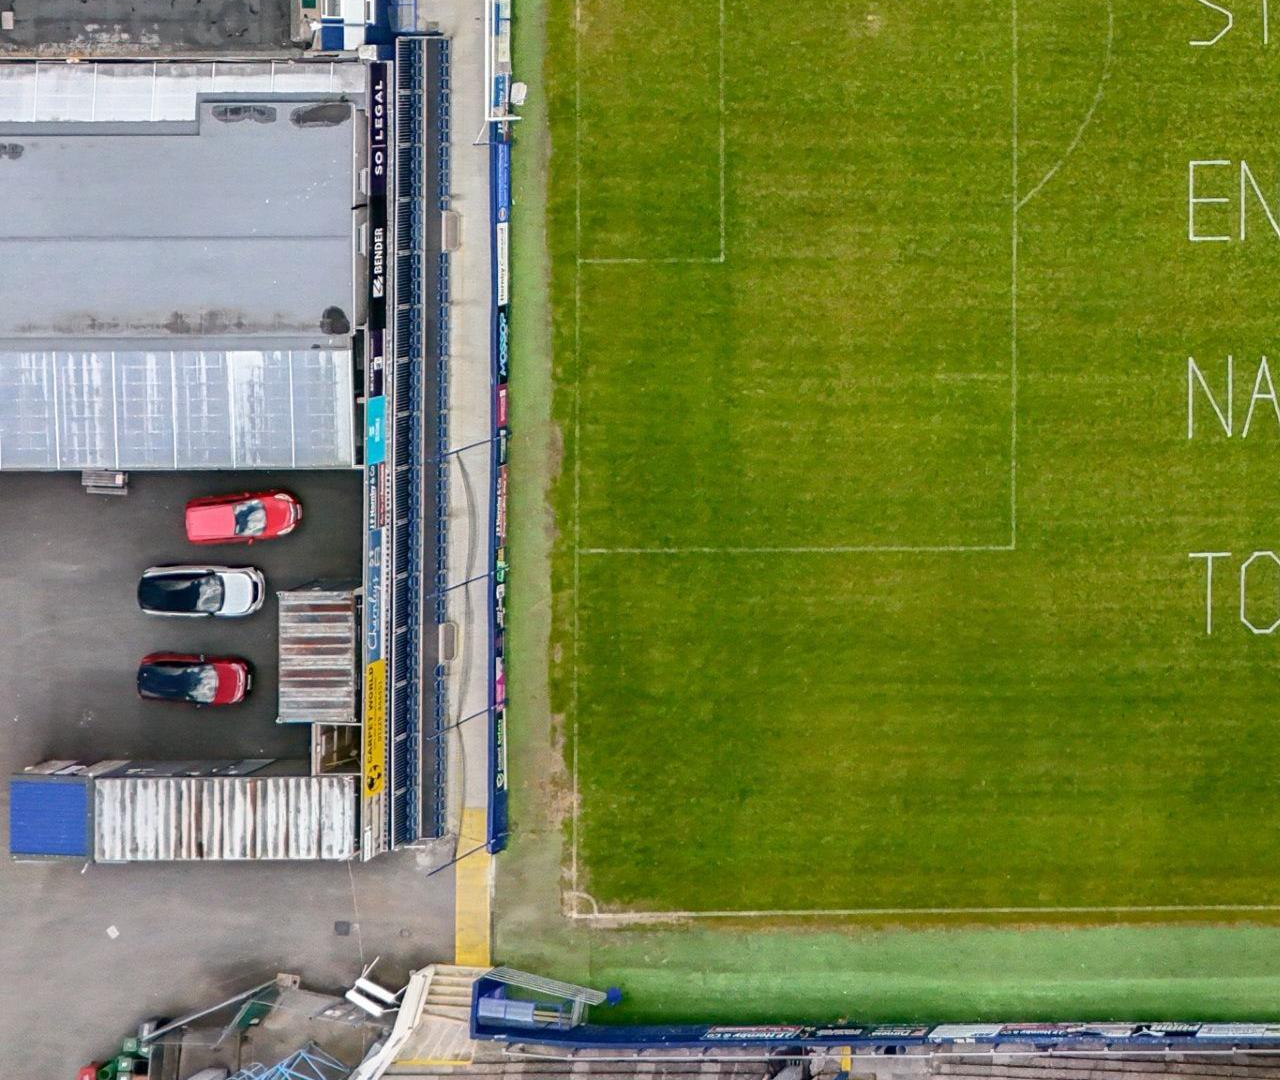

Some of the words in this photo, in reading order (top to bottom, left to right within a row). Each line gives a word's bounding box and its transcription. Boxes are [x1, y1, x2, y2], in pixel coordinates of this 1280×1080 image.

[374, 80, 383, 141] LEGAL
[374, 151, 383, 176] SO
[374, 227, 383, 275] BENDER
[499, 312, 507, 376] MOSSOP
[369, 465, 375, 477] Co
